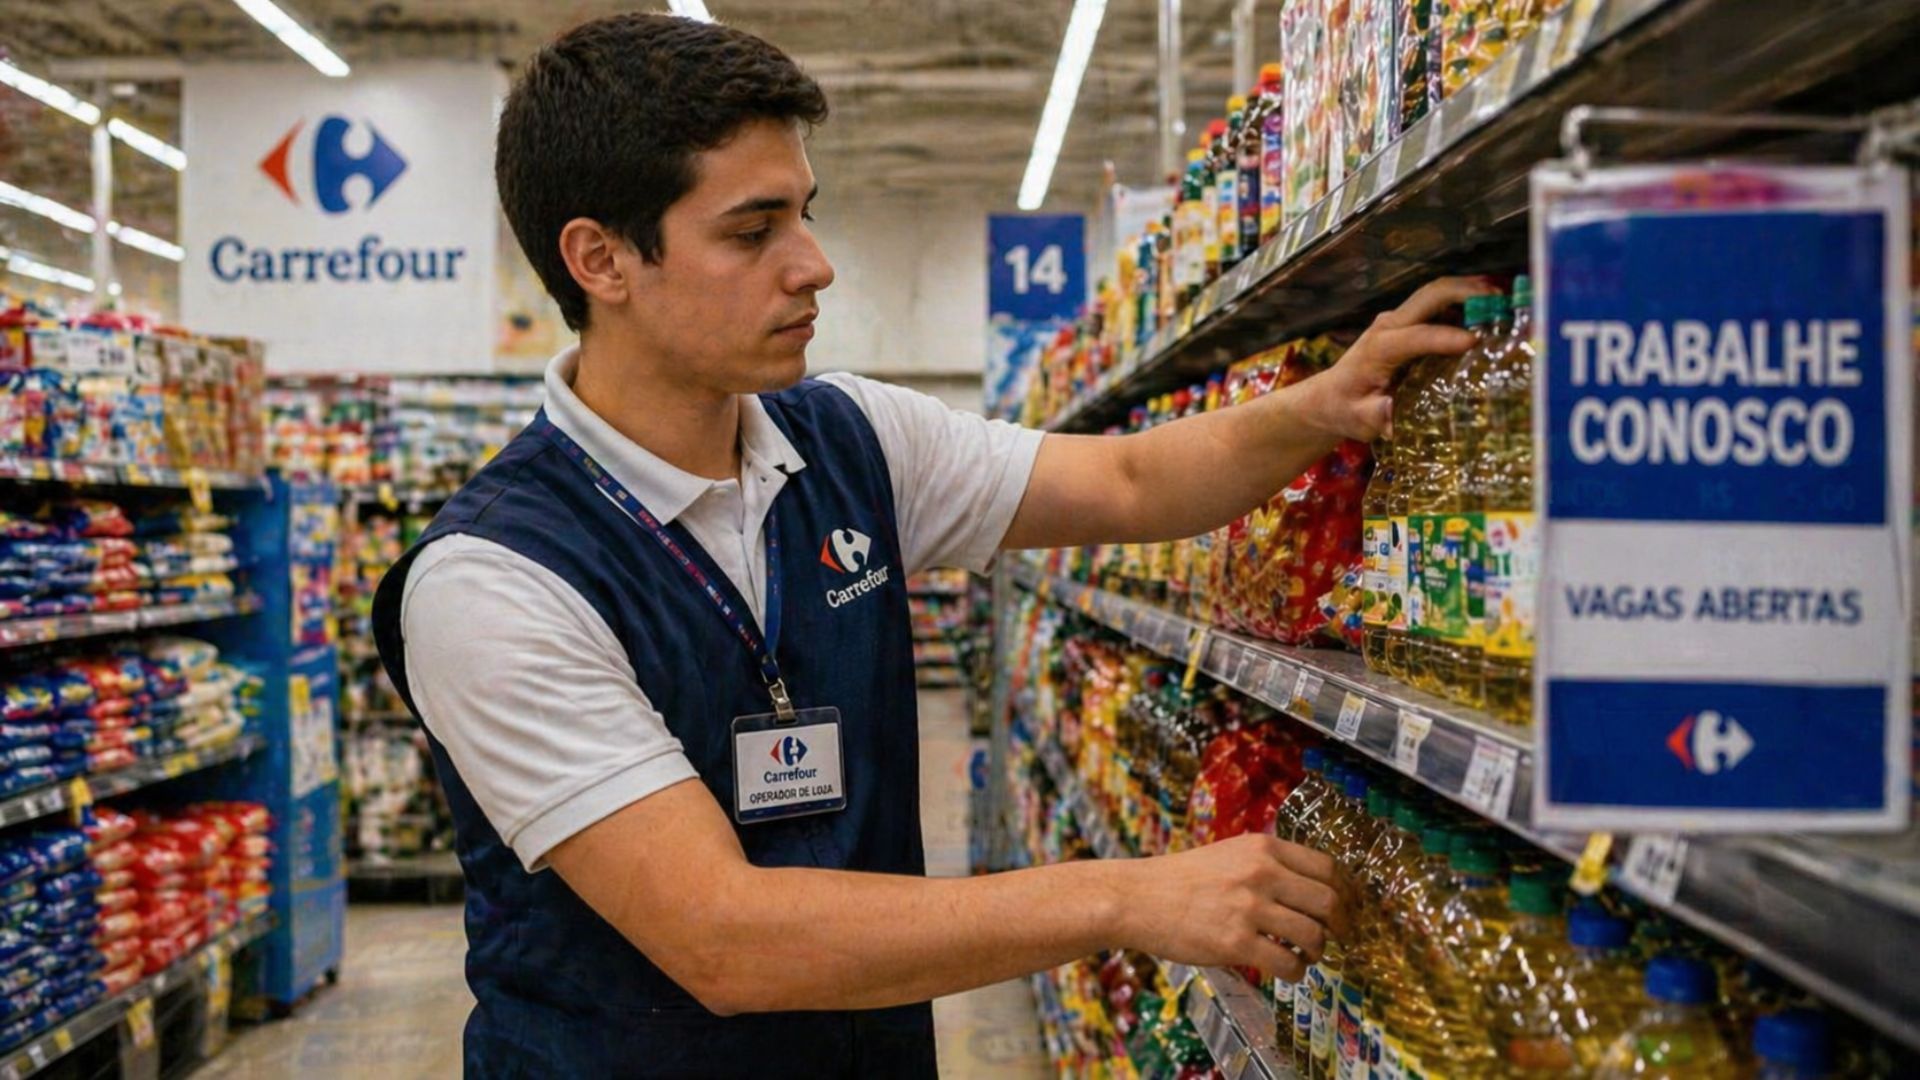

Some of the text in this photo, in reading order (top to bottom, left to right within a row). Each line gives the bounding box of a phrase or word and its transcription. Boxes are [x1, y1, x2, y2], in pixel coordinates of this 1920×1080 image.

[209, 234, 466, 283] Carrefour
[1004, 244, 1068, 294] 14
[1560, 319, 1863, 387] TRABALHE
[1568, 396, 1854, 466] CONOSCO
[826, 565, 889, 608] Carrefour
[1564, 585, 1863, 625] VAGAS ABERTAS
[749, 788, 798, 804] OPERADOR
[798, 786, 811, 798] DE
[763, 767, 818, 784] Carrefour
